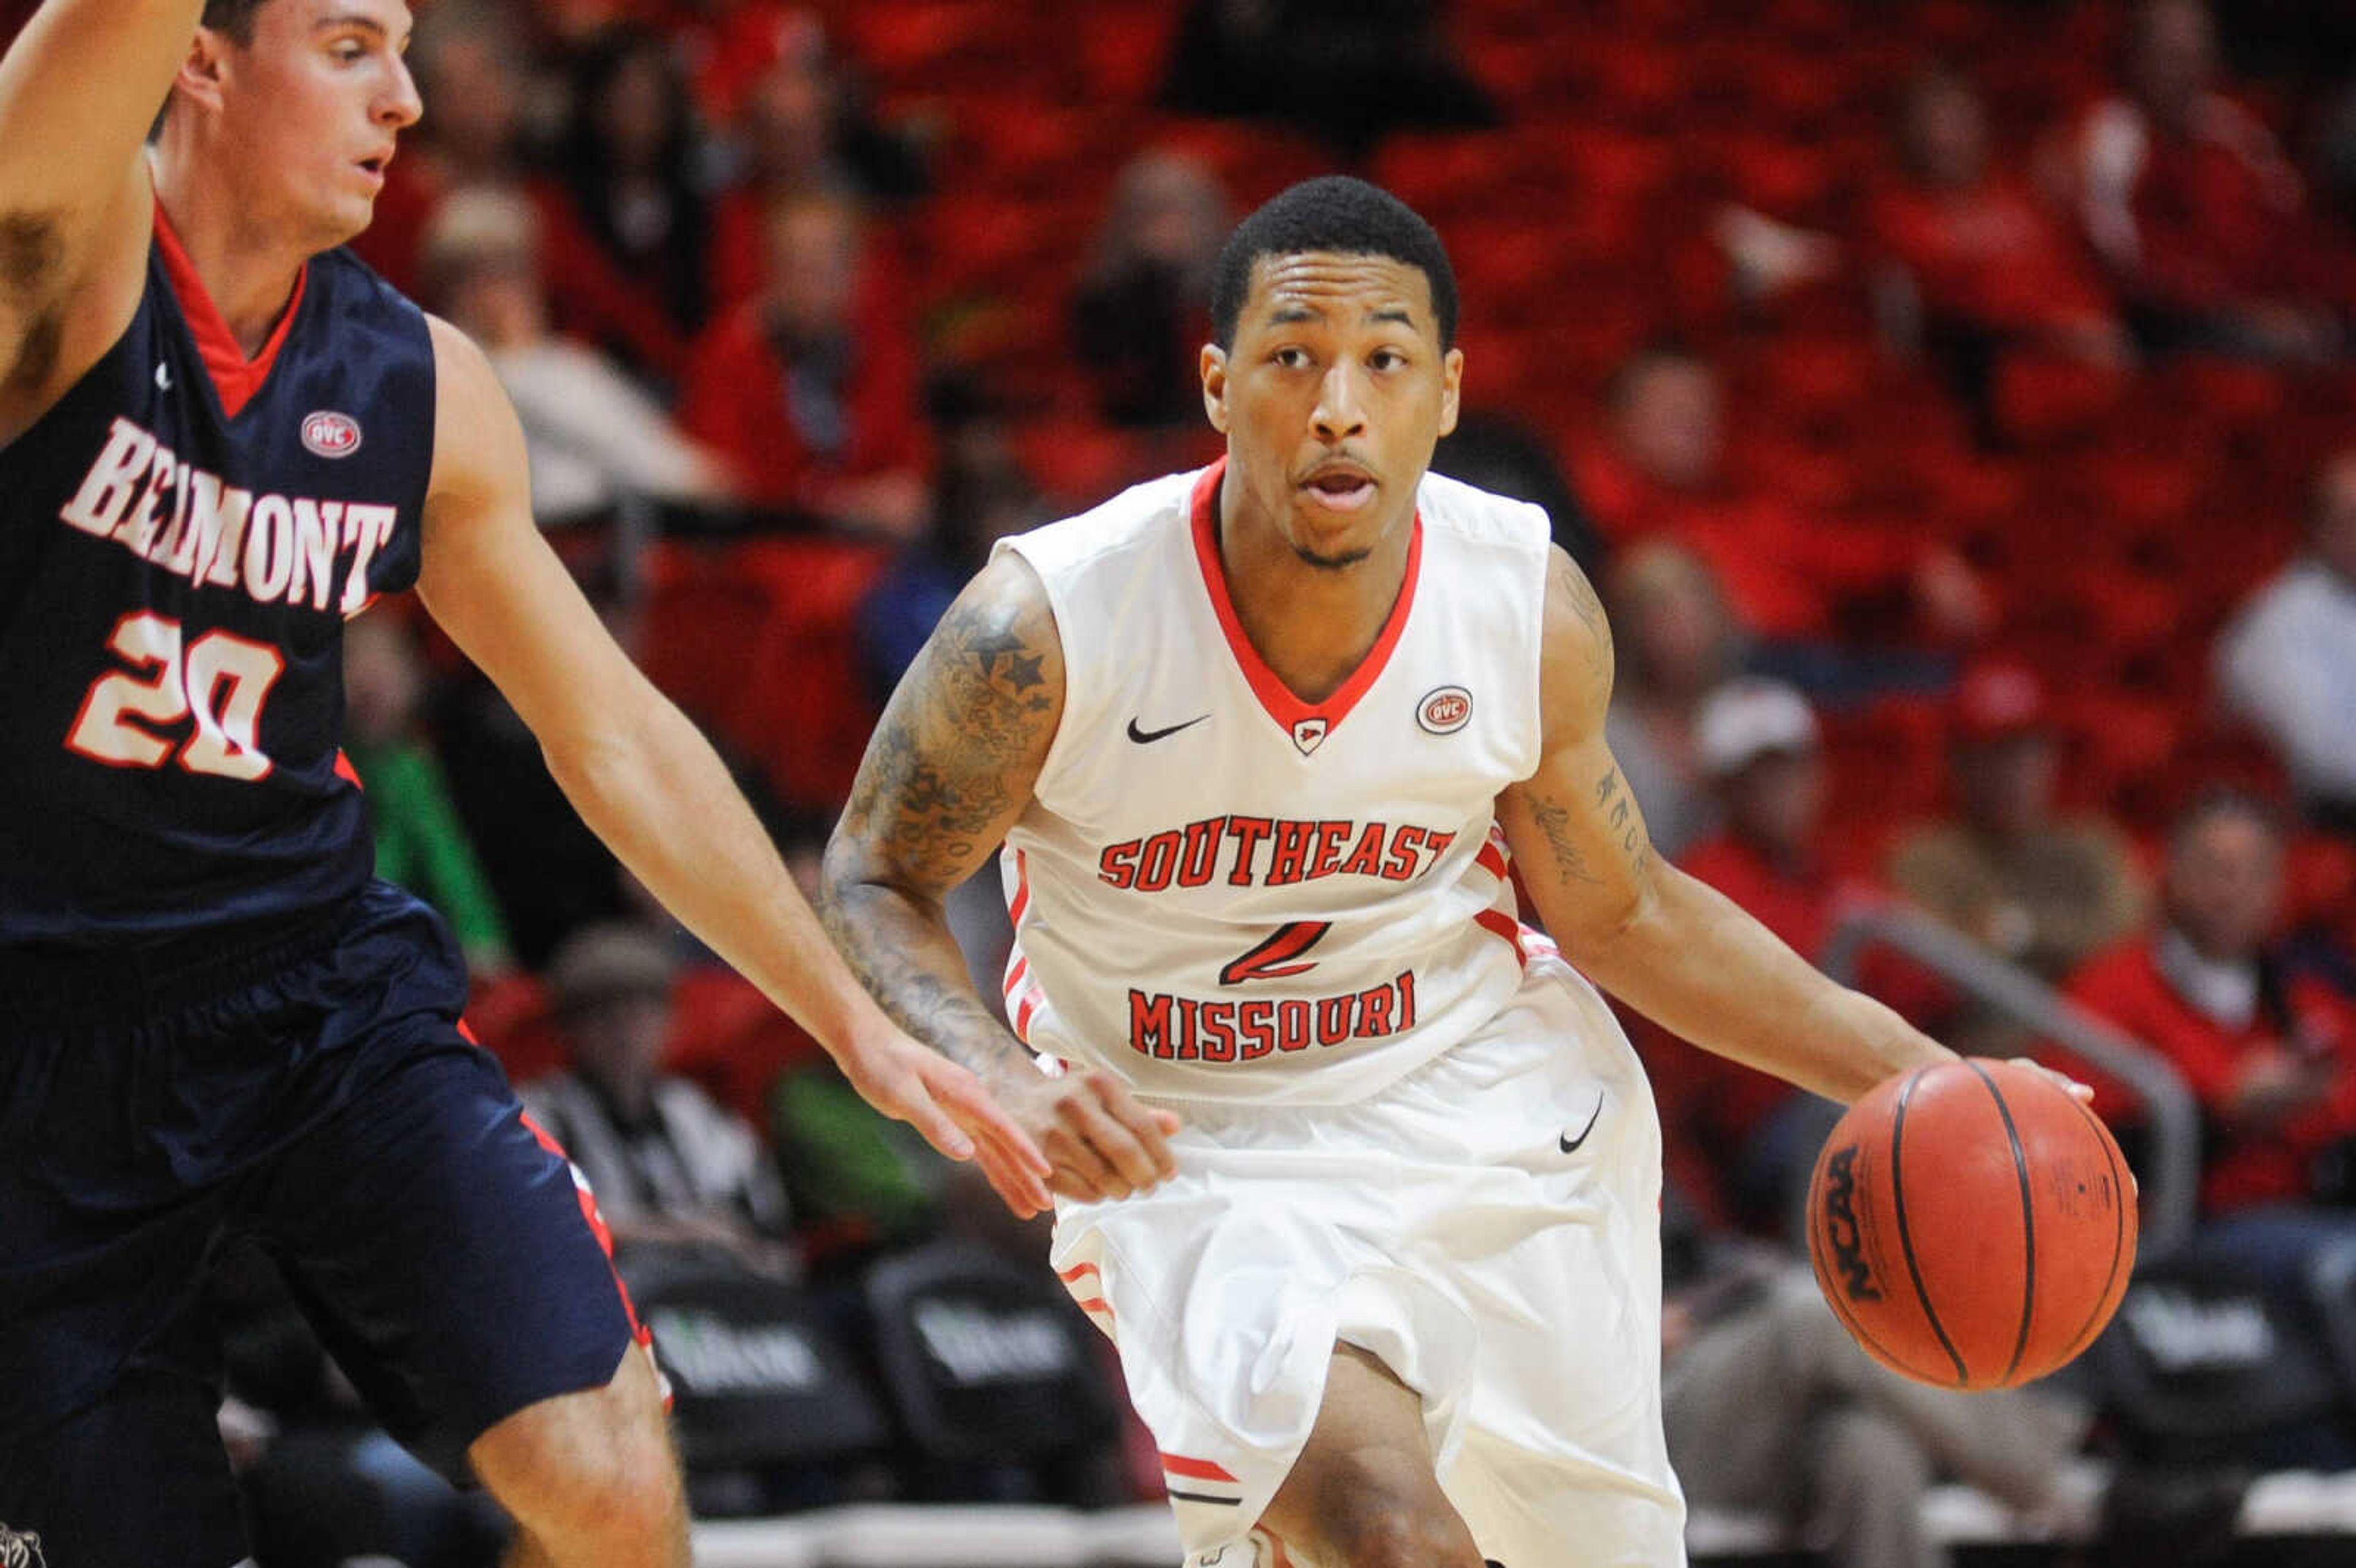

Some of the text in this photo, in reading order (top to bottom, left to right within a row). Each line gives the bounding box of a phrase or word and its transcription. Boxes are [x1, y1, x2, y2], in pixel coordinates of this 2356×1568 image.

[312, 424, 345, 444] OVC
[59, 415, 398, 614] BELMONT
[64, 609, 285, 782] 20
[1433, 701, 1460, 720] OVC
[1098, 814, 1457, 893] SOUTHEAST
[1128, 970, 1416, 1063] MISSOURI
[1827, 1143, 1882, 1302] NCAA
